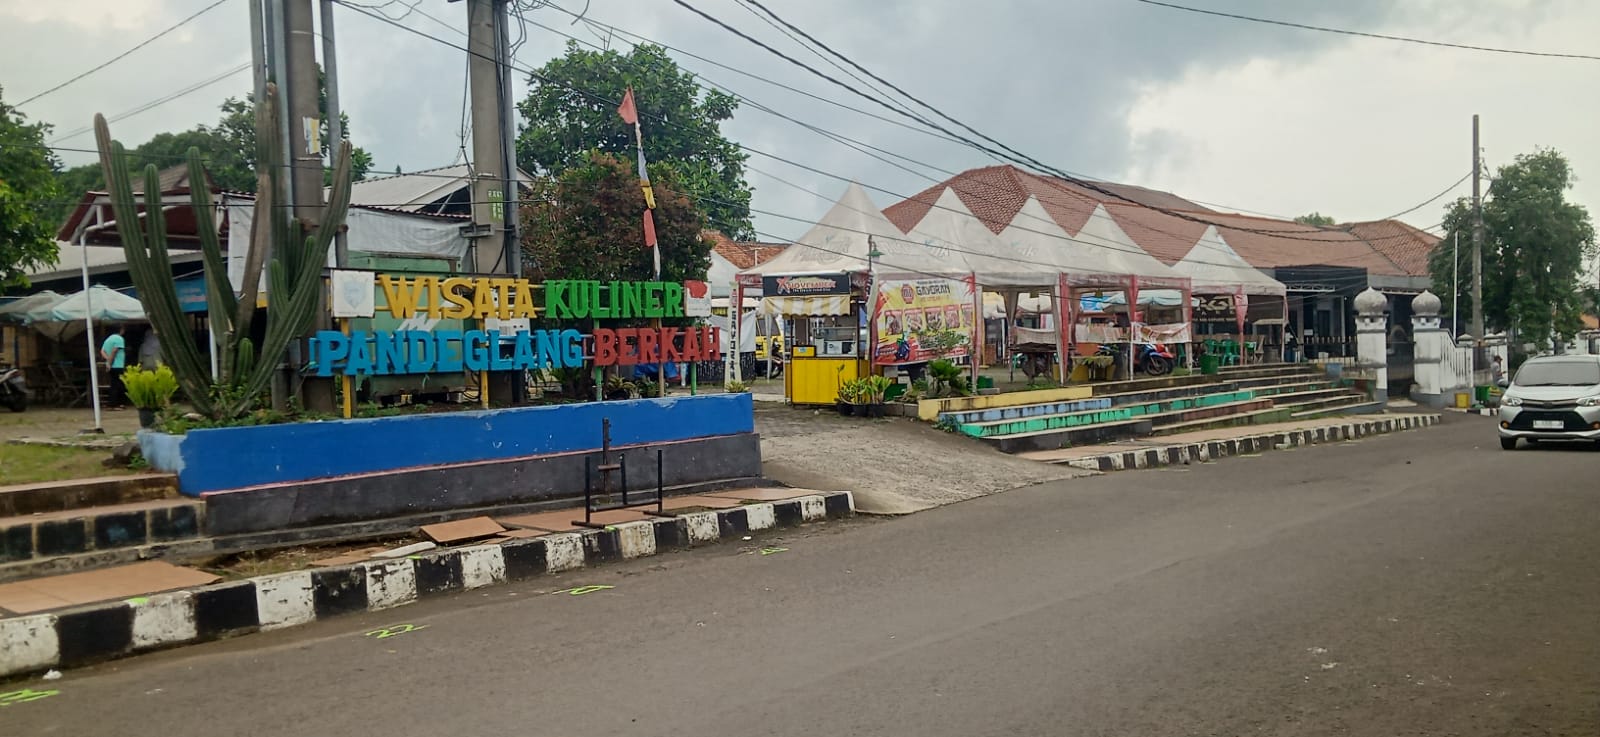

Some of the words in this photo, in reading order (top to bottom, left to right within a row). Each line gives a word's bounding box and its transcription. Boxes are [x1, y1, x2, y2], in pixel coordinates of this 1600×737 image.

[378, 274, 537, 319] WISATA
[544, 279, 684, 319] KULINER
[315, 328, 583, 377] PANDEGLANG
[592, 326, 721, 366] BERKAH
